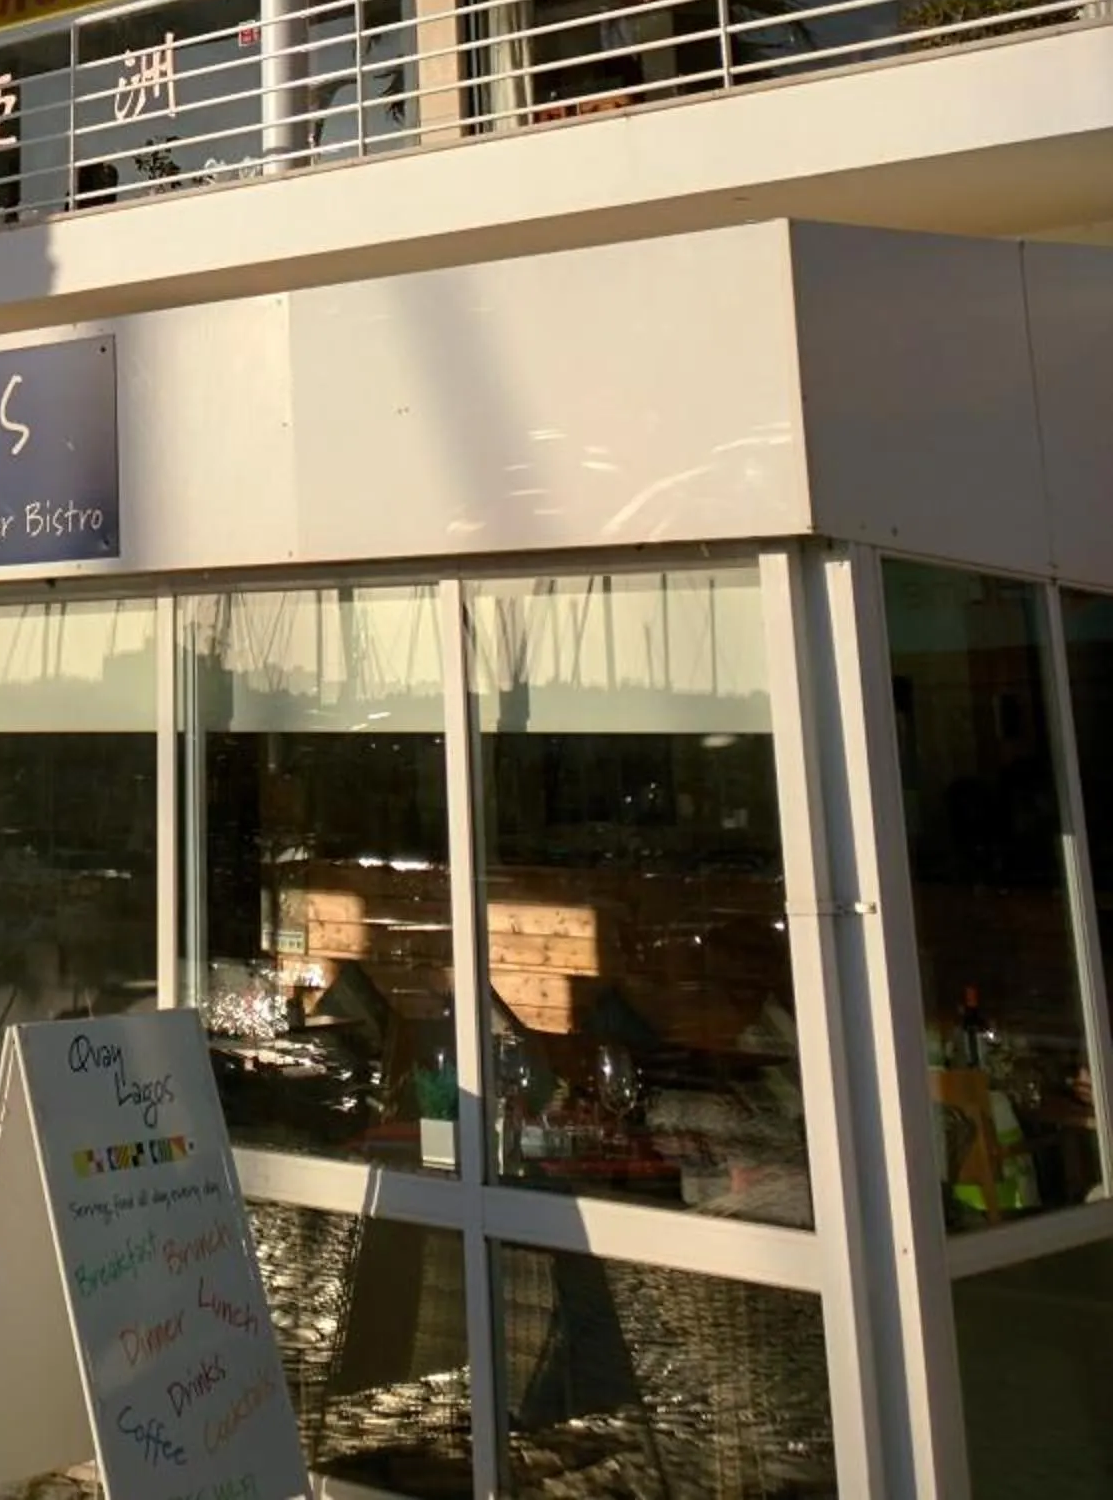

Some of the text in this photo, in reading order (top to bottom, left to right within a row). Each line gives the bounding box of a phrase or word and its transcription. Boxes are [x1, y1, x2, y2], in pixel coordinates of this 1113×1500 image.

[24, 500, 104, 537] Bistro
[114, 1073, 175, 1128] Lagos
[74, 1218, 232, 1297] Breakfast Brunch
[119, 1275, 260, 1367] Dinner Lunch
[166, 1352, 227, 1419] Drinks
[116, 1405, 187, 1467] Coffee
